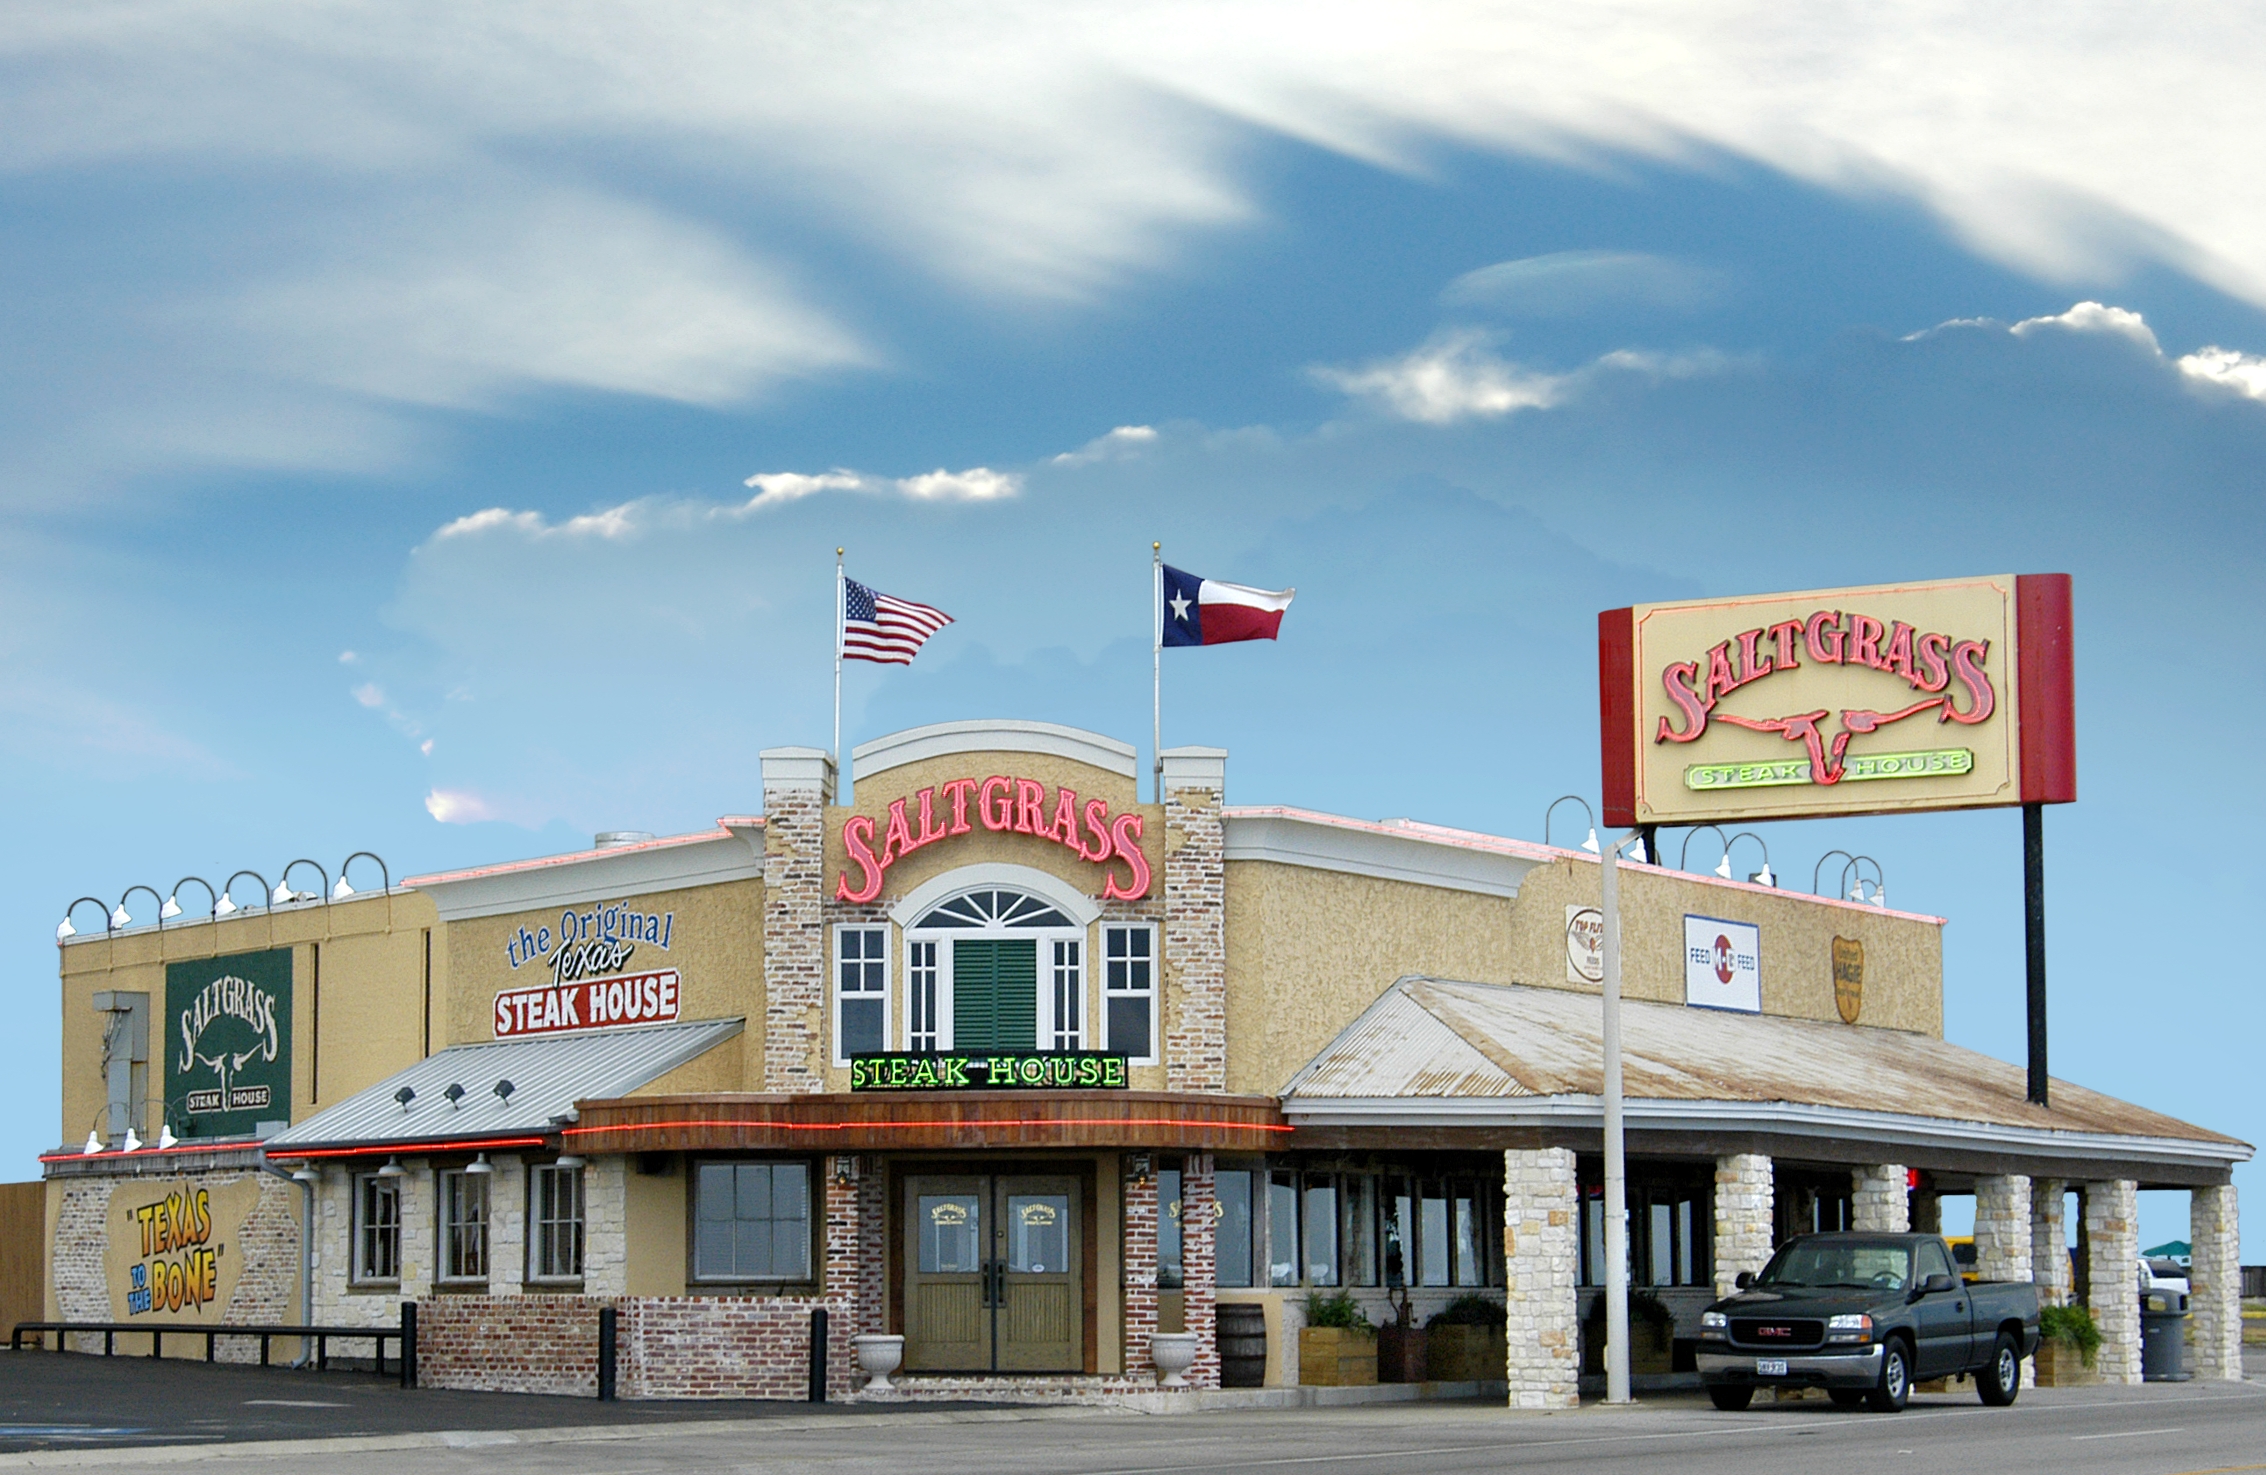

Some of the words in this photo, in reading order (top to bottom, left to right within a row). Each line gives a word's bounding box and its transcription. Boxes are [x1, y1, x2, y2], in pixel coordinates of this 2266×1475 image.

[1654, 610, 1994, 743] SALTGRASS
[1700, 765, 1799, 784] STEAK
[1856, 754, 1972, 775] HOUSE
[835, 775, 1151, 901] SALTGRASS
[506, 925, 551, 970] the
[561, 901, 674, 951] Original
[548, 937, 634, 988] Texas
[1690, 947, 1710, 964] FEED
[1737, 954, 1755, 970] FEED
[497, 987, 580, 1033] STEAK
[589, 974, 677, 1023] HOUSE
[178, 975, 278, 1075] SALTGRASS
[852, 1057, 970, 1087] STEAK
[986, 1056, 1123, 1086] HOUSE
[189, 1094, 220, 1109] STEAK
[233, 1090, 268, 1104] HOUSE
[130, 1262, 147, 1290] TO
[127, 1286, 151, 1316] THE
[1758, 1327, 1792, 1337] GMC
